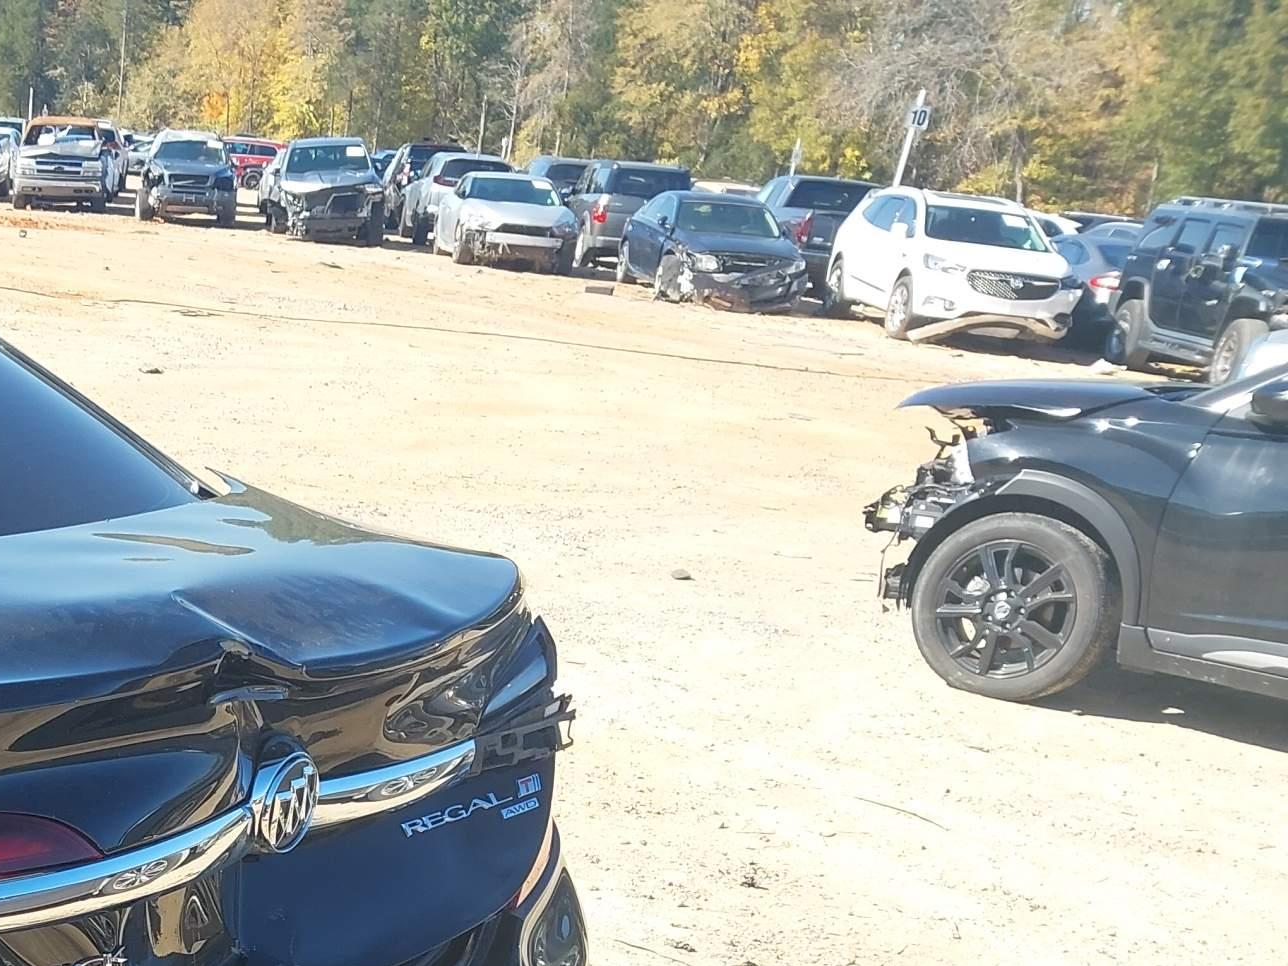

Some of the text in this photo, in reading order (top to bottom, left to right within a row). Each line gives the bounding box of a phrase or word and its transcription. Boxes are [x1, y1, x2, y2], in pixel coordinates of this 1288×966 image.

[912, 110, 927, 126] 10
[401, 792, 513, 838] REGAL
[503, 799, 538, 818] AWD
